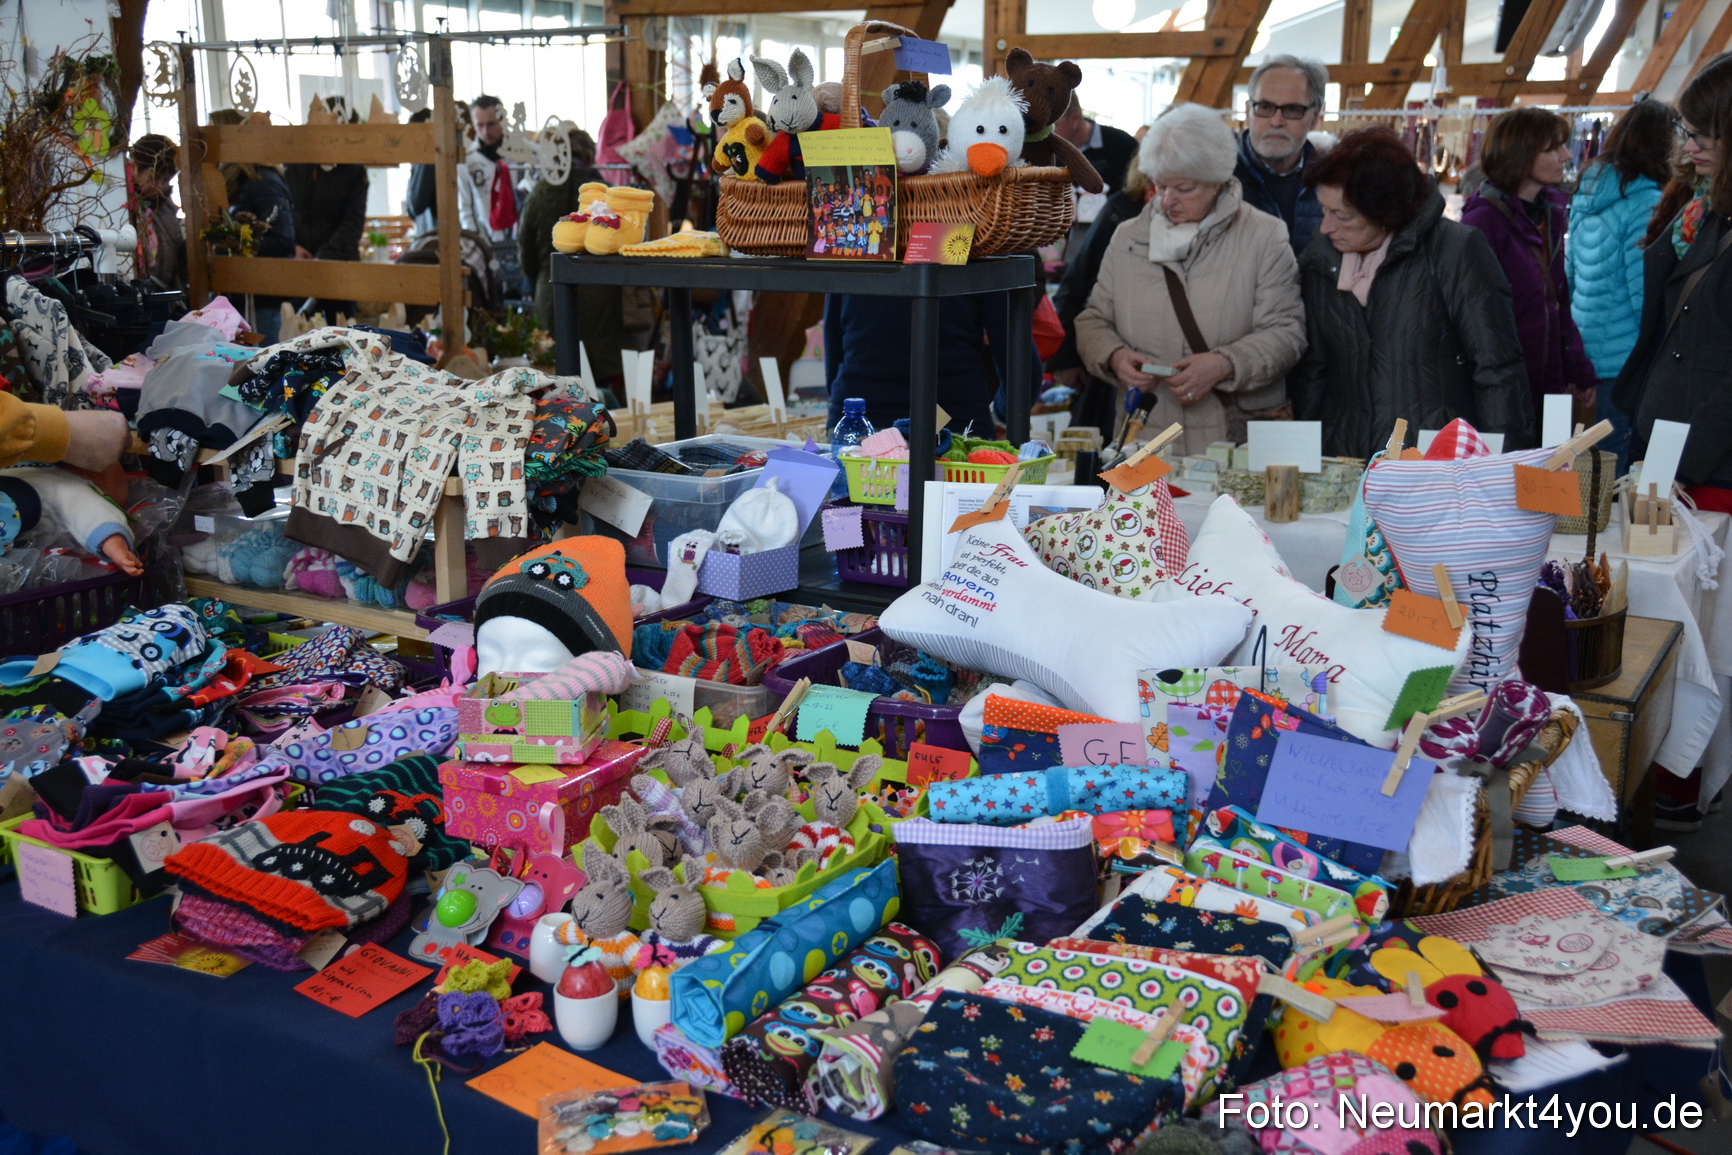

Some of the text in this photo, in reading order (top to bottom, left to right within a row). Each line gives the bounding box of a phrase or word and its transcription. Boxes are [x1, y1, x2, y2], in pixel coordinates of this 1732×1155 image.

[960, 550, 1007, 575] ist perfekt,
[966, 534, 1029, 568] Keine Frau
[941, 571, 995, 601] Bayern
[966, 565, 982, 578] die
[981, 573, 1000, 587] aus
[921, 591, 979, 628] nah dran!
[941, 588, 997, 612] verdammt
[1273, 624, 1347, 684] Mama
